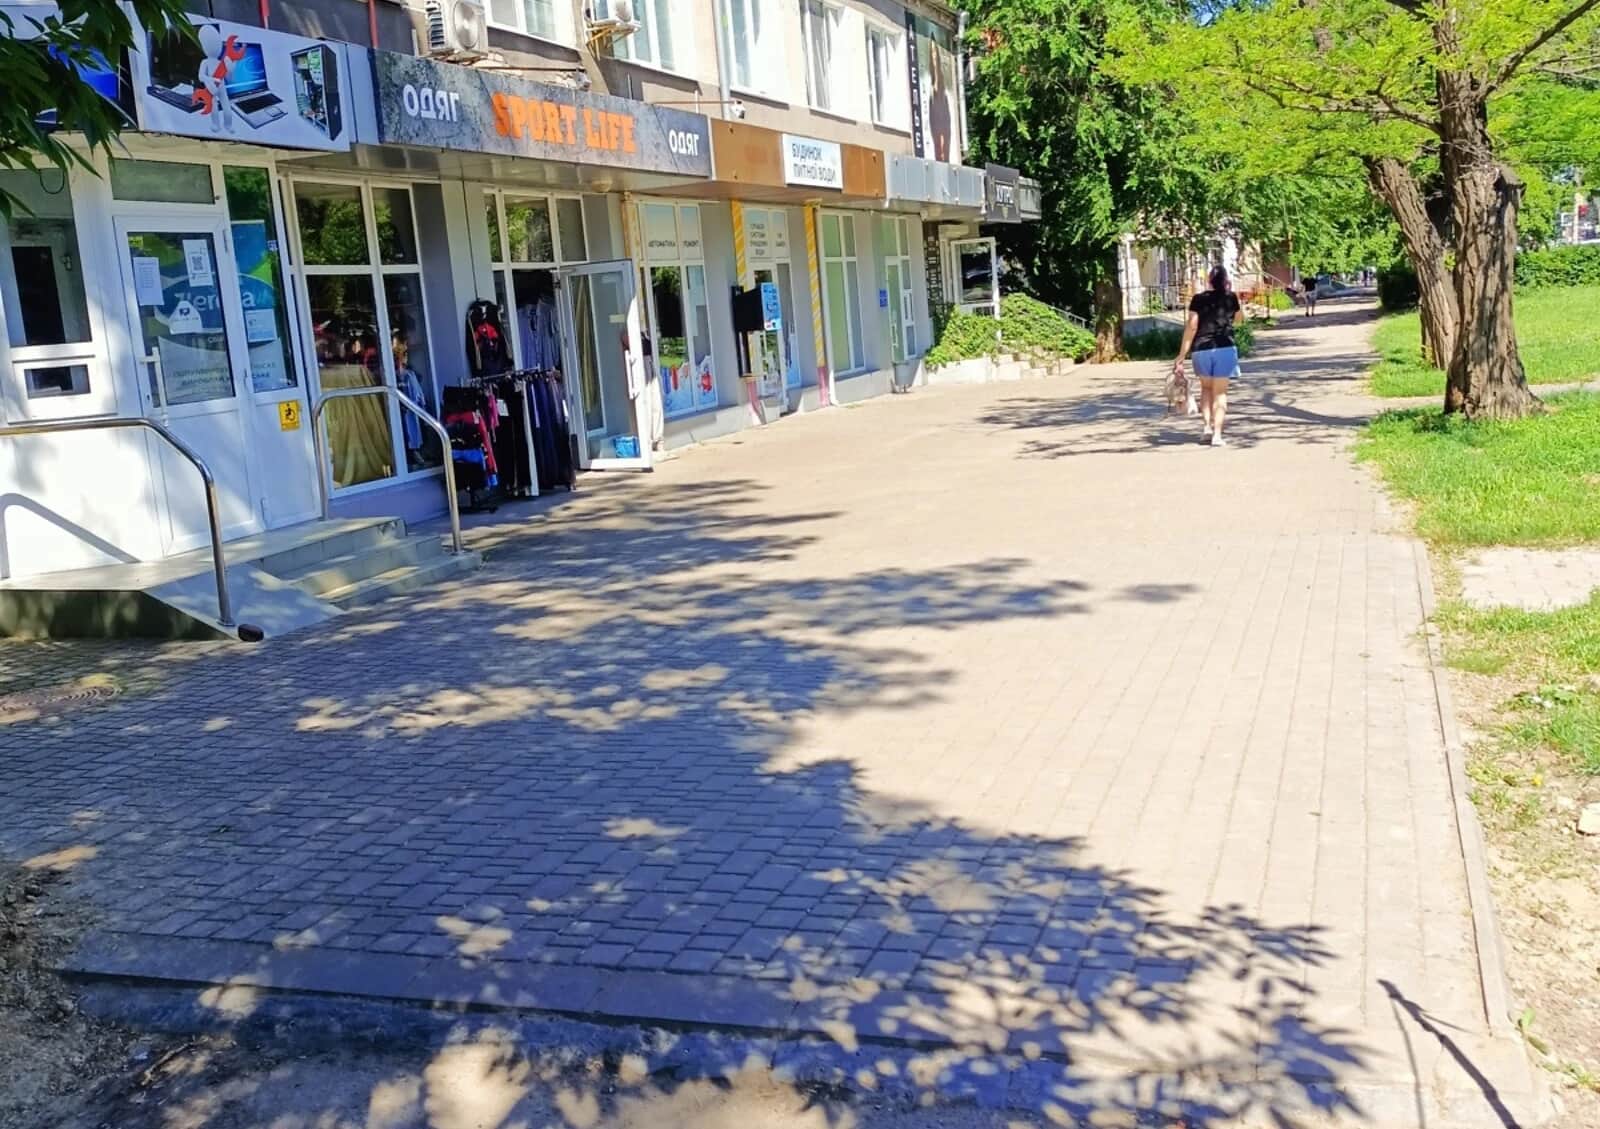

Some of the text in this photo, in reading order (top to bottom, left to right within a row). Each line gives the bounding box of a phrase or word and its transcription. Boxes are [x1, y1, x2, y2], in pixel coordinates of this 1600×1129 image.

[403, 84, 459, 121] ОДЯГ
[491, 91, 636, 153] SPORT LIFE
[669, 129, 700, 156] ОДЯГ
[792, 143, 822, 161] БУДИНОК
[793, 162, 836, 184] ПИТНОЇ ВОДИ
